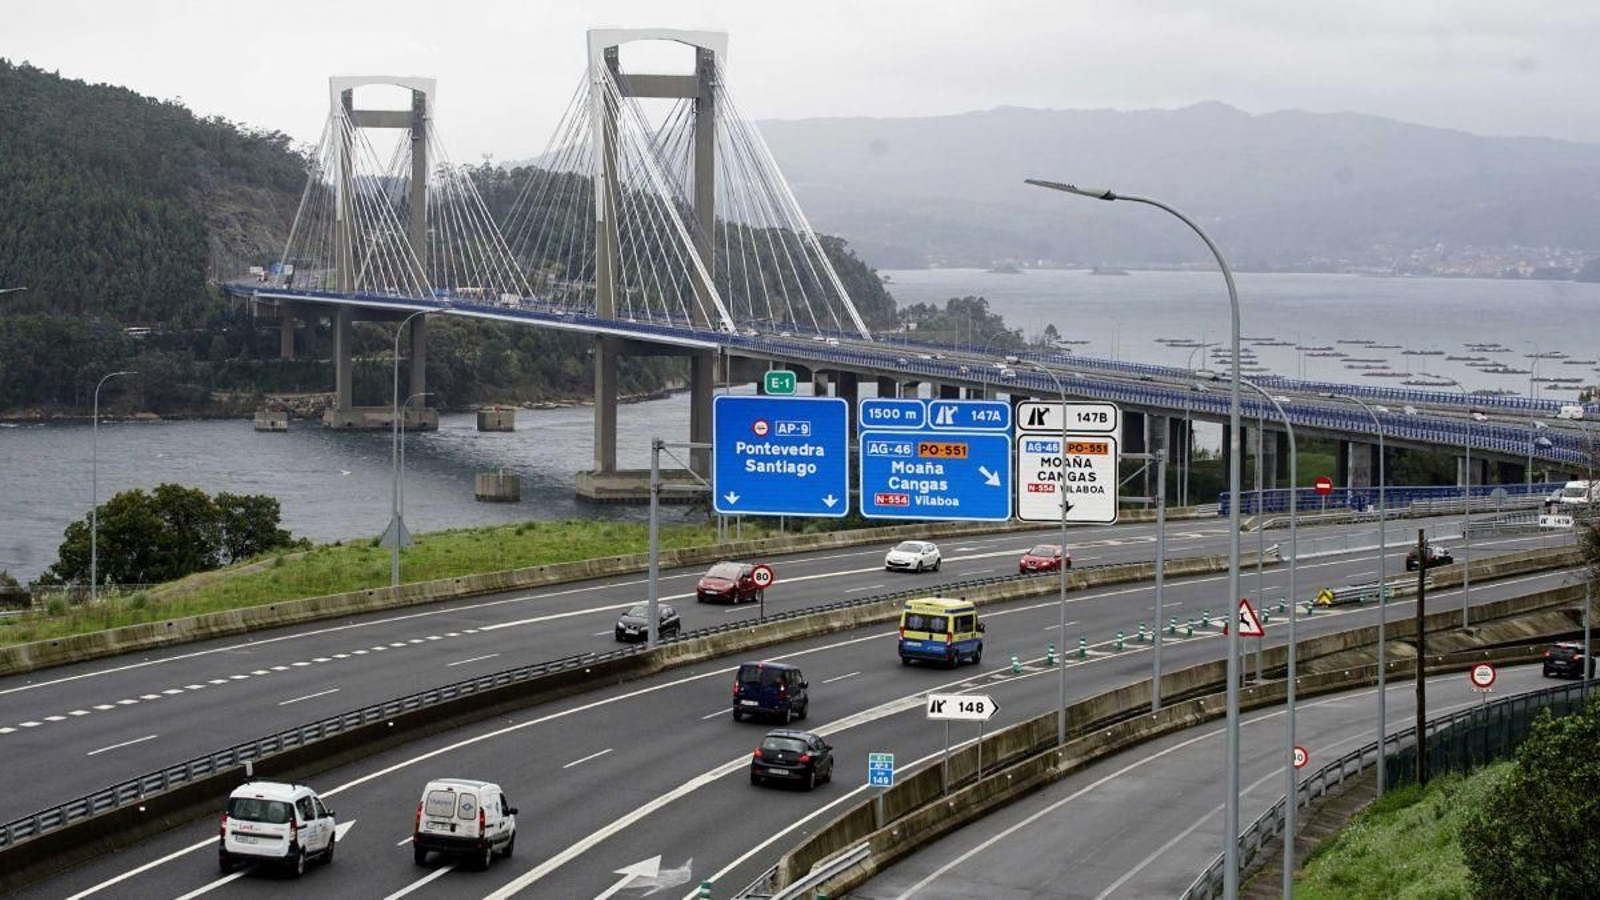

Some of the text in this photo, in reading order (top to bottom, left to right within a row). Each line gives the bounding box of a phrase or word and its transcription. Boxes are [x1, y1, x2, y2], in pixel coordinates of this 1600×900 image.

[771, 378, 790, 388] E-1
[868, 408, 917, 419] 1500 m
[971, 410, 1002, 421] 147A
[1077, 412, 1108, 423] 147B
[778, 423, 809, 434] AP-9
[735, 441, 825, 457] Pontevedra
[869, 443, 967, 456] AG-46 PO-551
[1068, 444, 1108, 453] PO-551
[745, 459, 817, 477] Santiago
[891, 461, 944, 475] Moaña
[888, 477, 948, 494] Cangas
[876, 495, 960, 507] N-554 Vilaboa
[756, 572, 769, 580] 80
[959, 702, 984, 713] 148
[873, 775, 889, 784] 149
